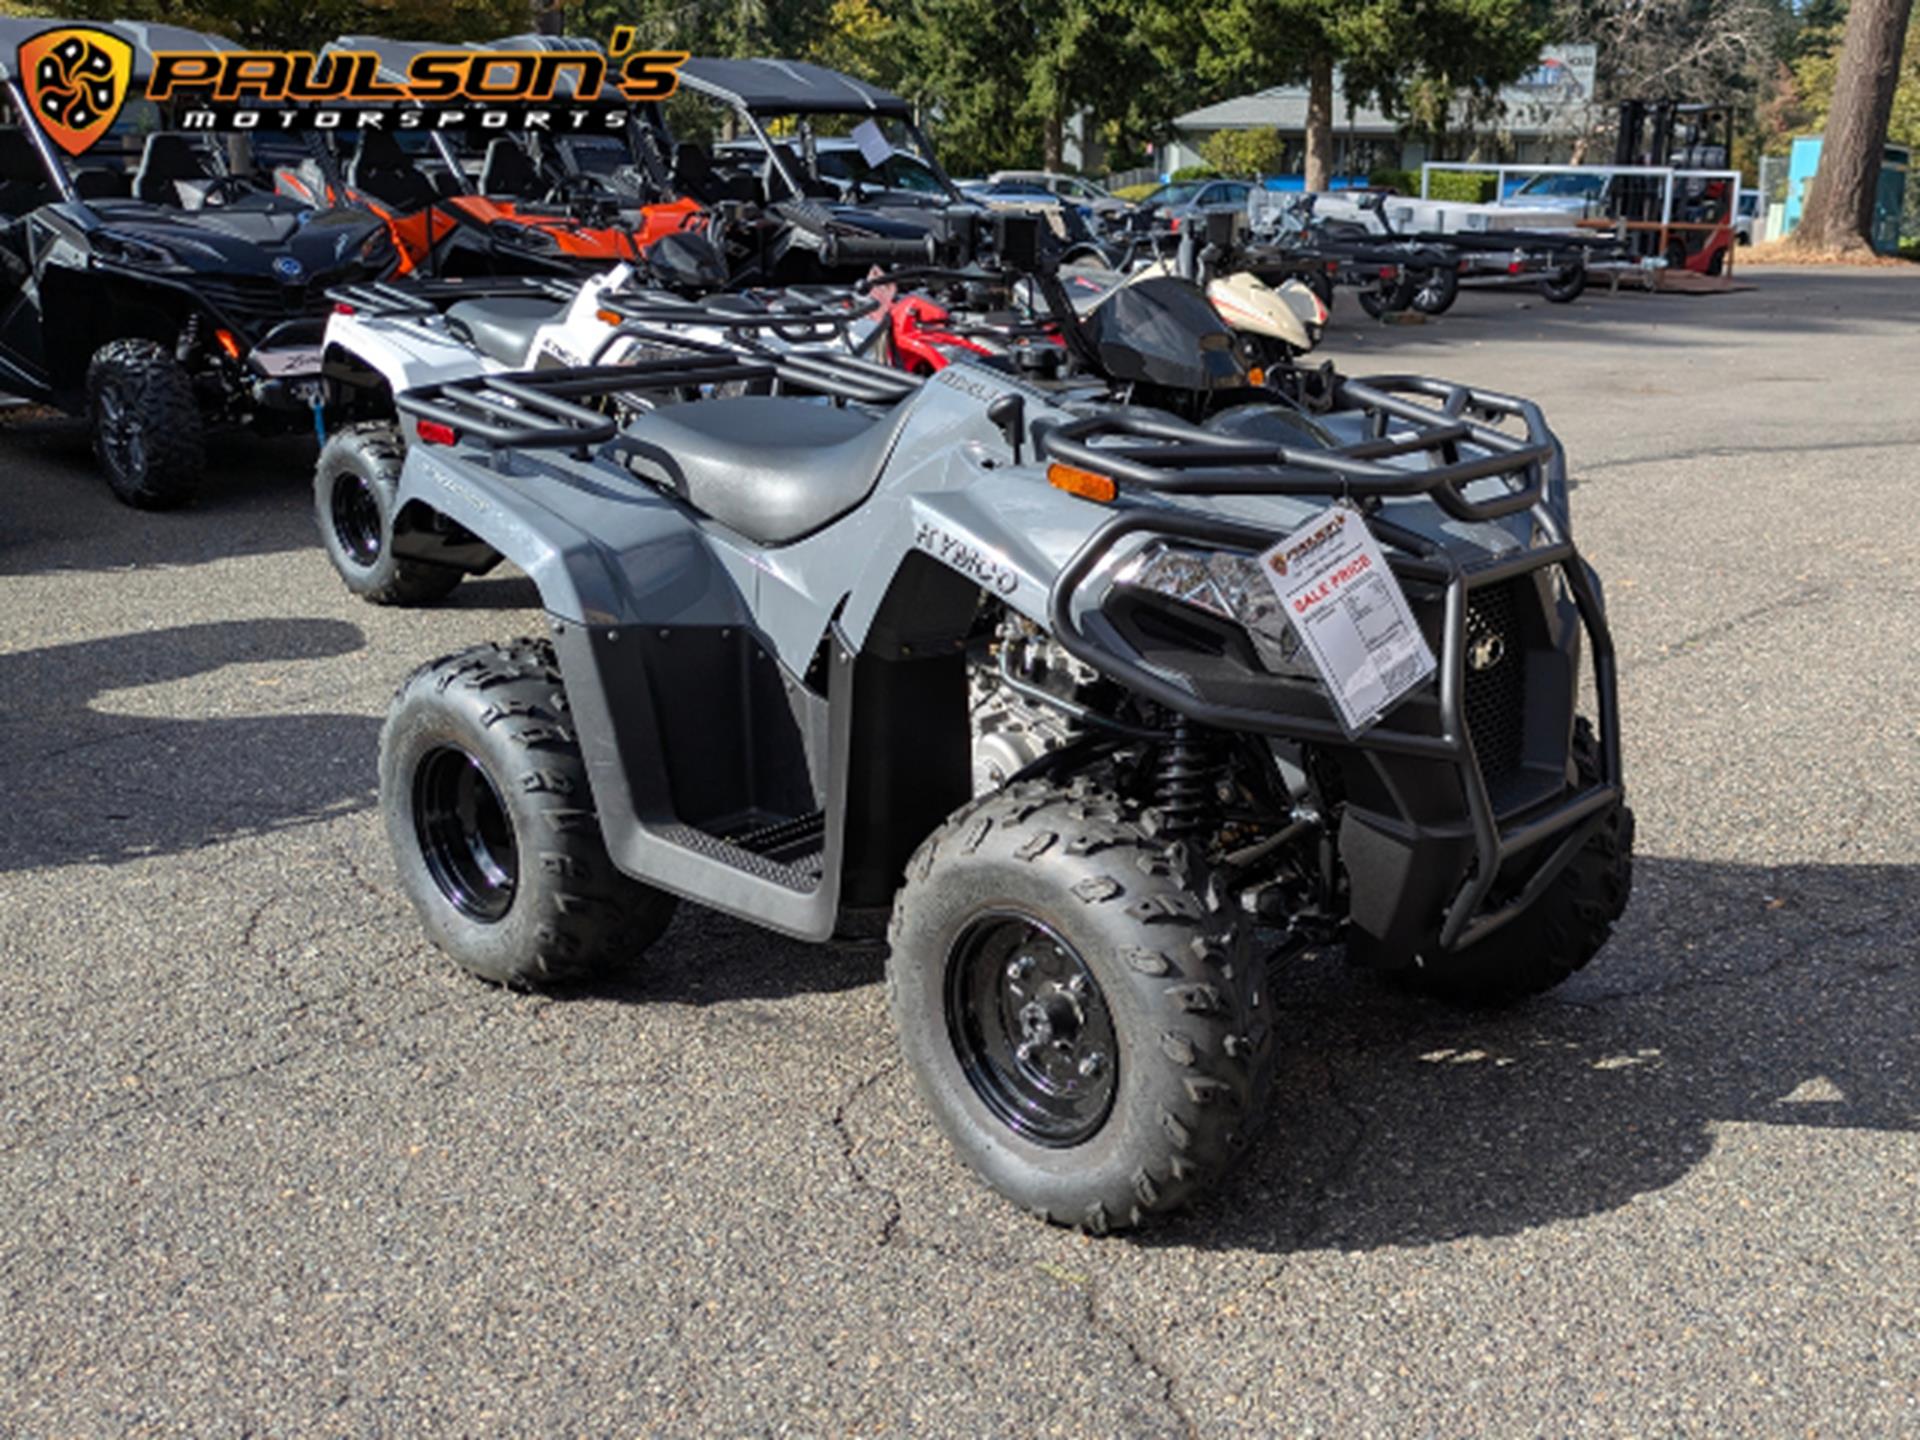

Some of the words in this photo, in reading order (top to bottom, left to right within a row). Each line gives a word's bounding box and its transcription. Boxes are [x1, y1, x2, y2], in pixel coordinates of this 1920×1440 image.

[915, 524, 1019, 596] KYMCO
[1294, 582, 1330, 613] SALE
[1331, 553, 1372, 586] PRICE
